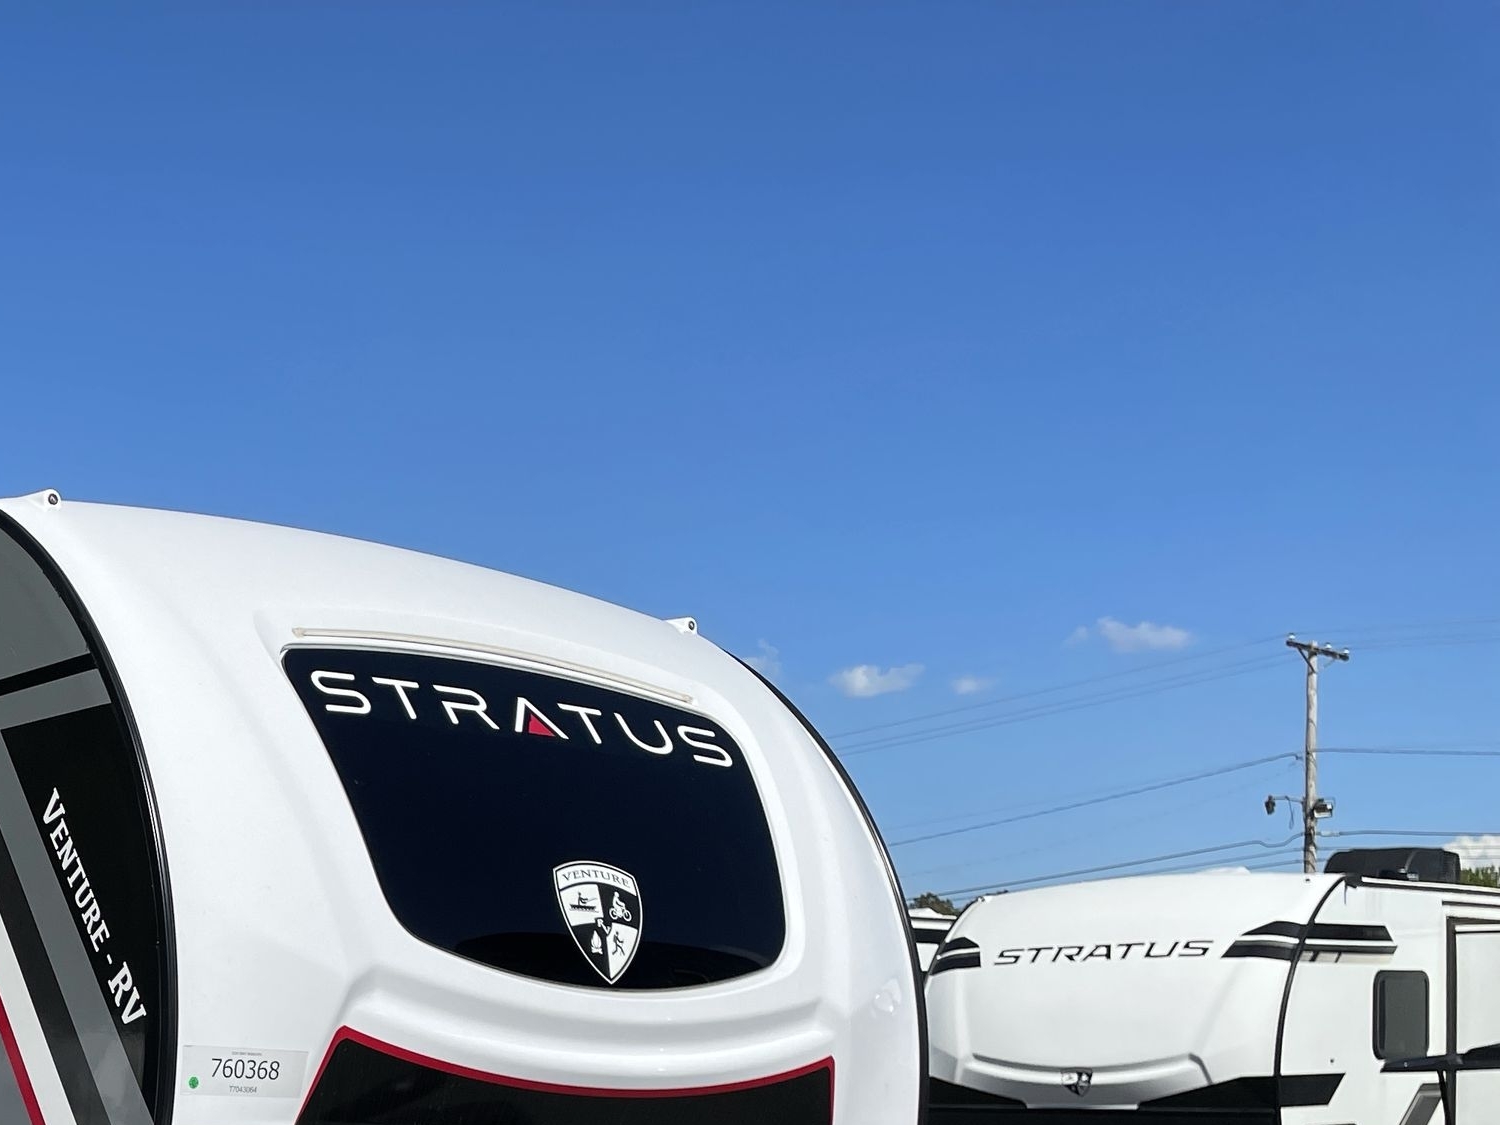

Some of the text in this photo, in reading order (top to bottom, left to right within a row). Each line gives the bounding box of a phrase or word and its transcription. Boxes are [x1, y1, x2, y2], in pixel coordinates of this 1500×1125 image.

[310, 669, 733, 768] STRATUS
[562, 869, 631, 888] VENTURE
[42, 787, 110, 953] VENTURE
[107, 961, 147, 1025] RV
[994, 940, 1214, 966] STRATUS
[211, 1058, 280, 1080] 760368
